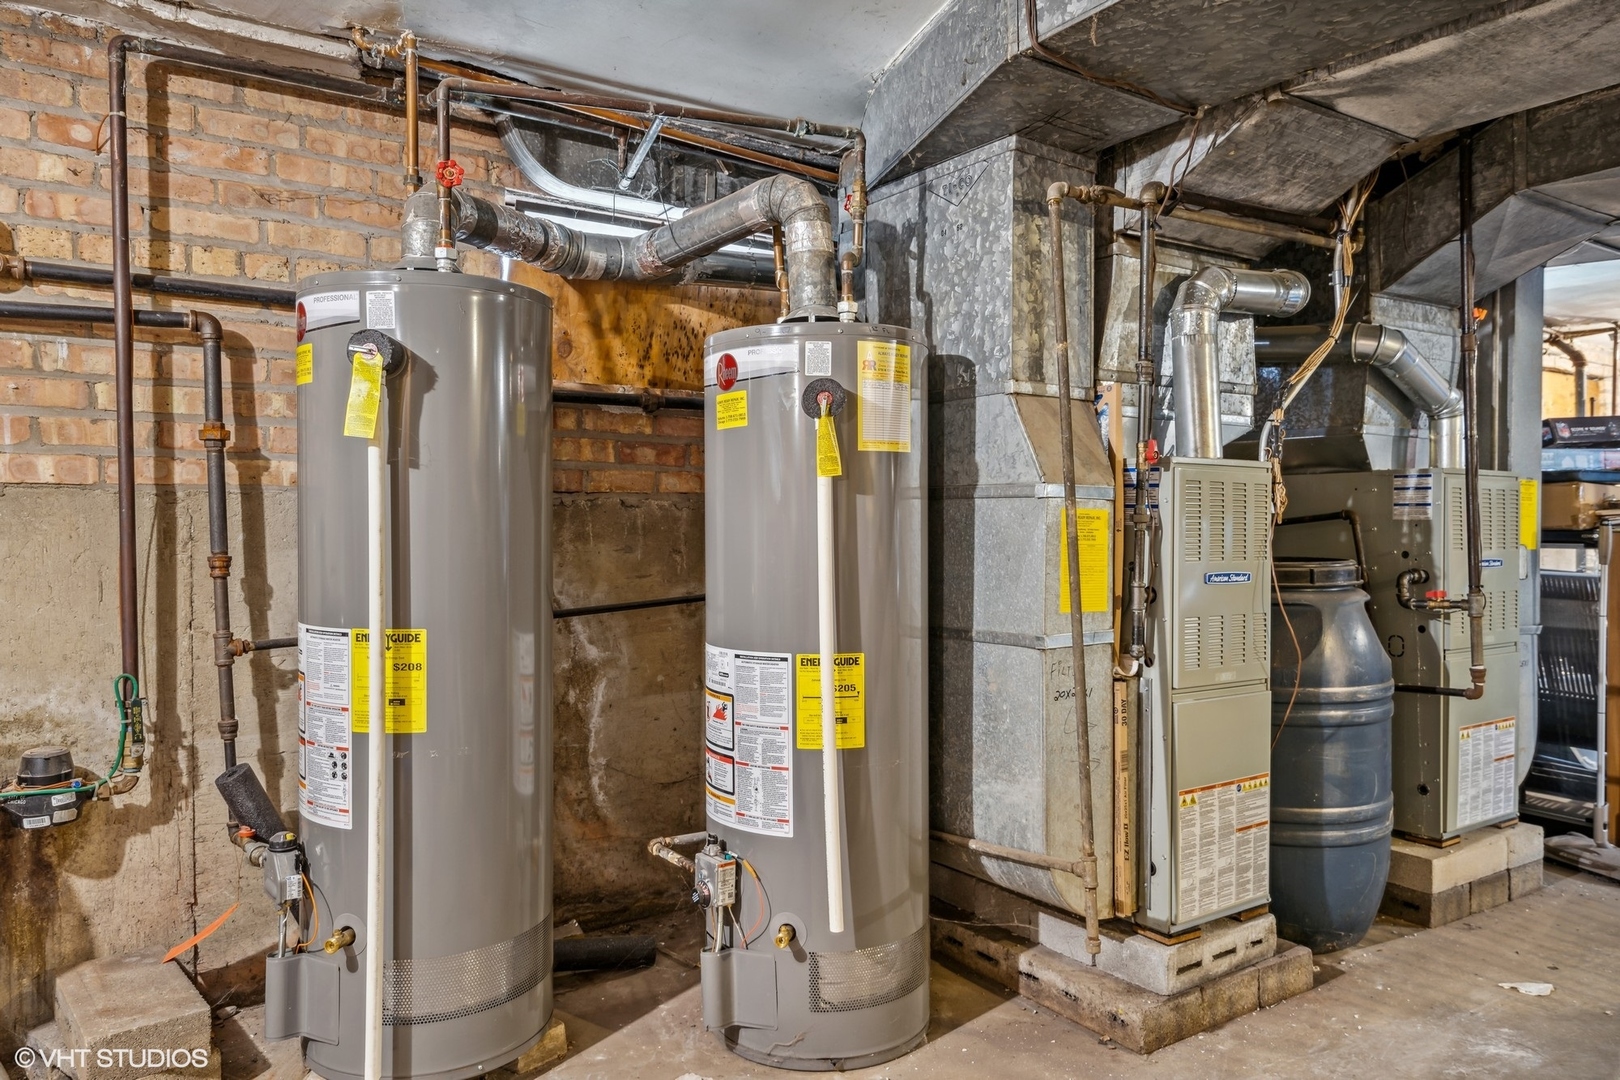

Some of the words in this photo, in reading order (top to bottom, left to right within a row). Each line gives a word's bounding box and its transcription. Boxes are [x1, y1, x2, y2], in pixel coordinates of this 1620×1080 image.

[718, 354, 737, 386] Rheem
[1229, 573, 1249, 582] Standard
[393, 662, 422, 672] $208
[1121, 716, 1128, 727] 30
